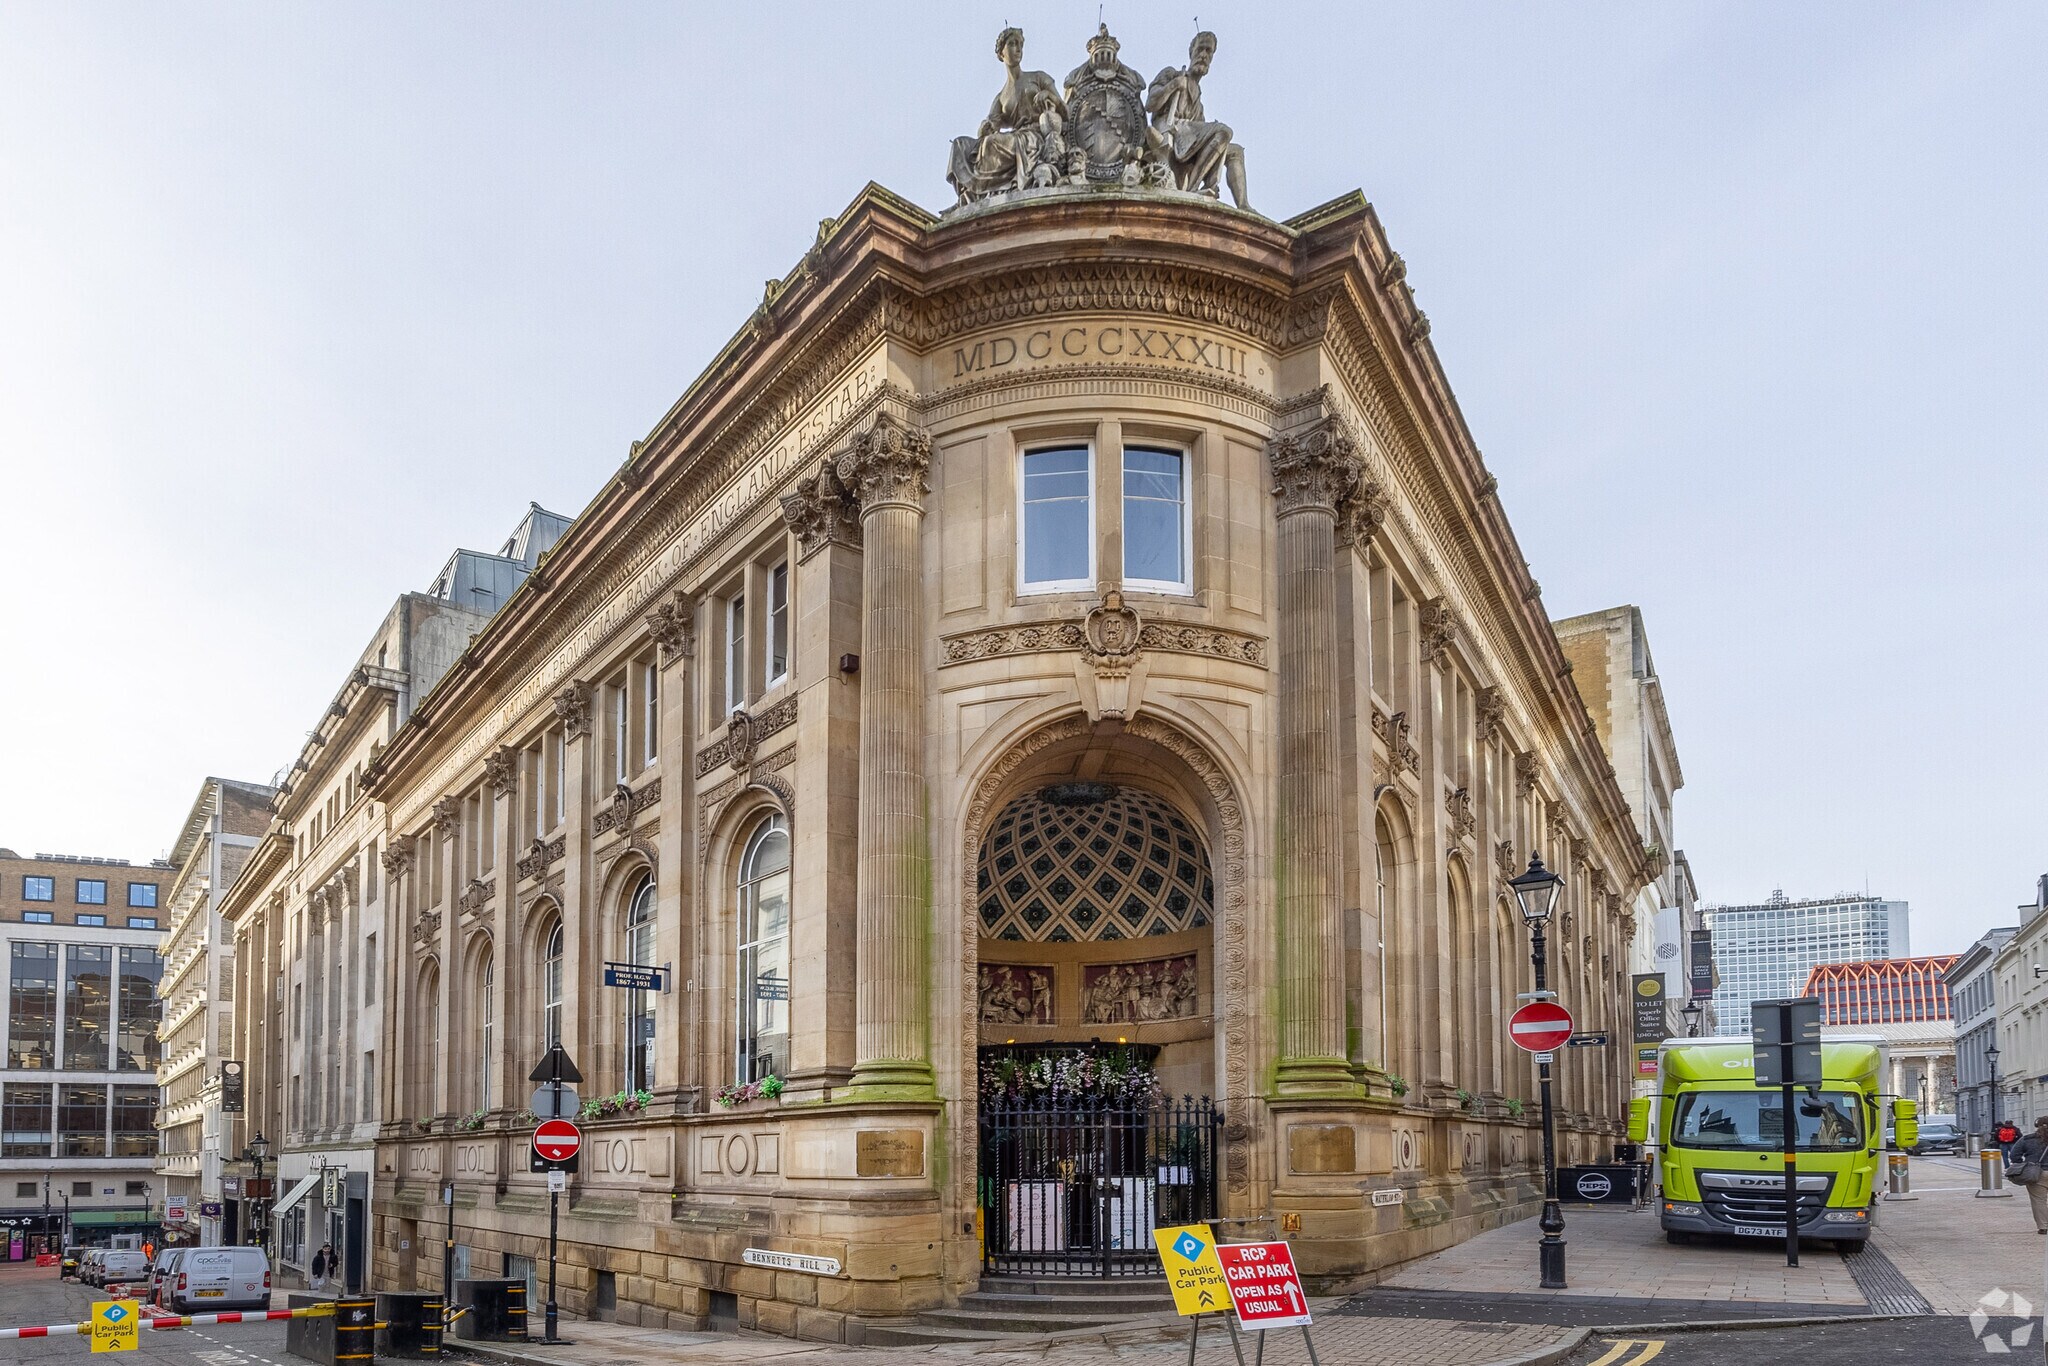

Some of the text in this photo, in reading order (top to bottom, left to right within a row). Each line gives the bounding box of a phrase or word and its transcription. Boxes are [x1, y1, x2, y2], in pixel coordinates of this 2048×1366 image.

[953, 327, 1247, 379] MDCCCXXXIII
[502, 672, 547, 725] NATIONAL
[552, 604, 620, 679] PROVINCIAL
[627, 560, 662, 611] BANK
[672, 533, 691, 567] OF
[700, 447, 788, 543] ENGLAND
[1738, 1227, 1783, 1236] DG73 ATF
[752, 1252, 792, 1267] BENNETTS
[799, 1259, 820, 1271] HILL
[1239, 1247, 1268, 1262] RCP
[1179, 1266, 1216, 1278] Public
[1227, 1263, 1293, 1280] CAR PARK
[1175, 1274, 1225, 1289] Car Park
[1234, 1284, 1283, 1298] OPEN AS
[1245, 1300, 1283, 1314] USUAL
